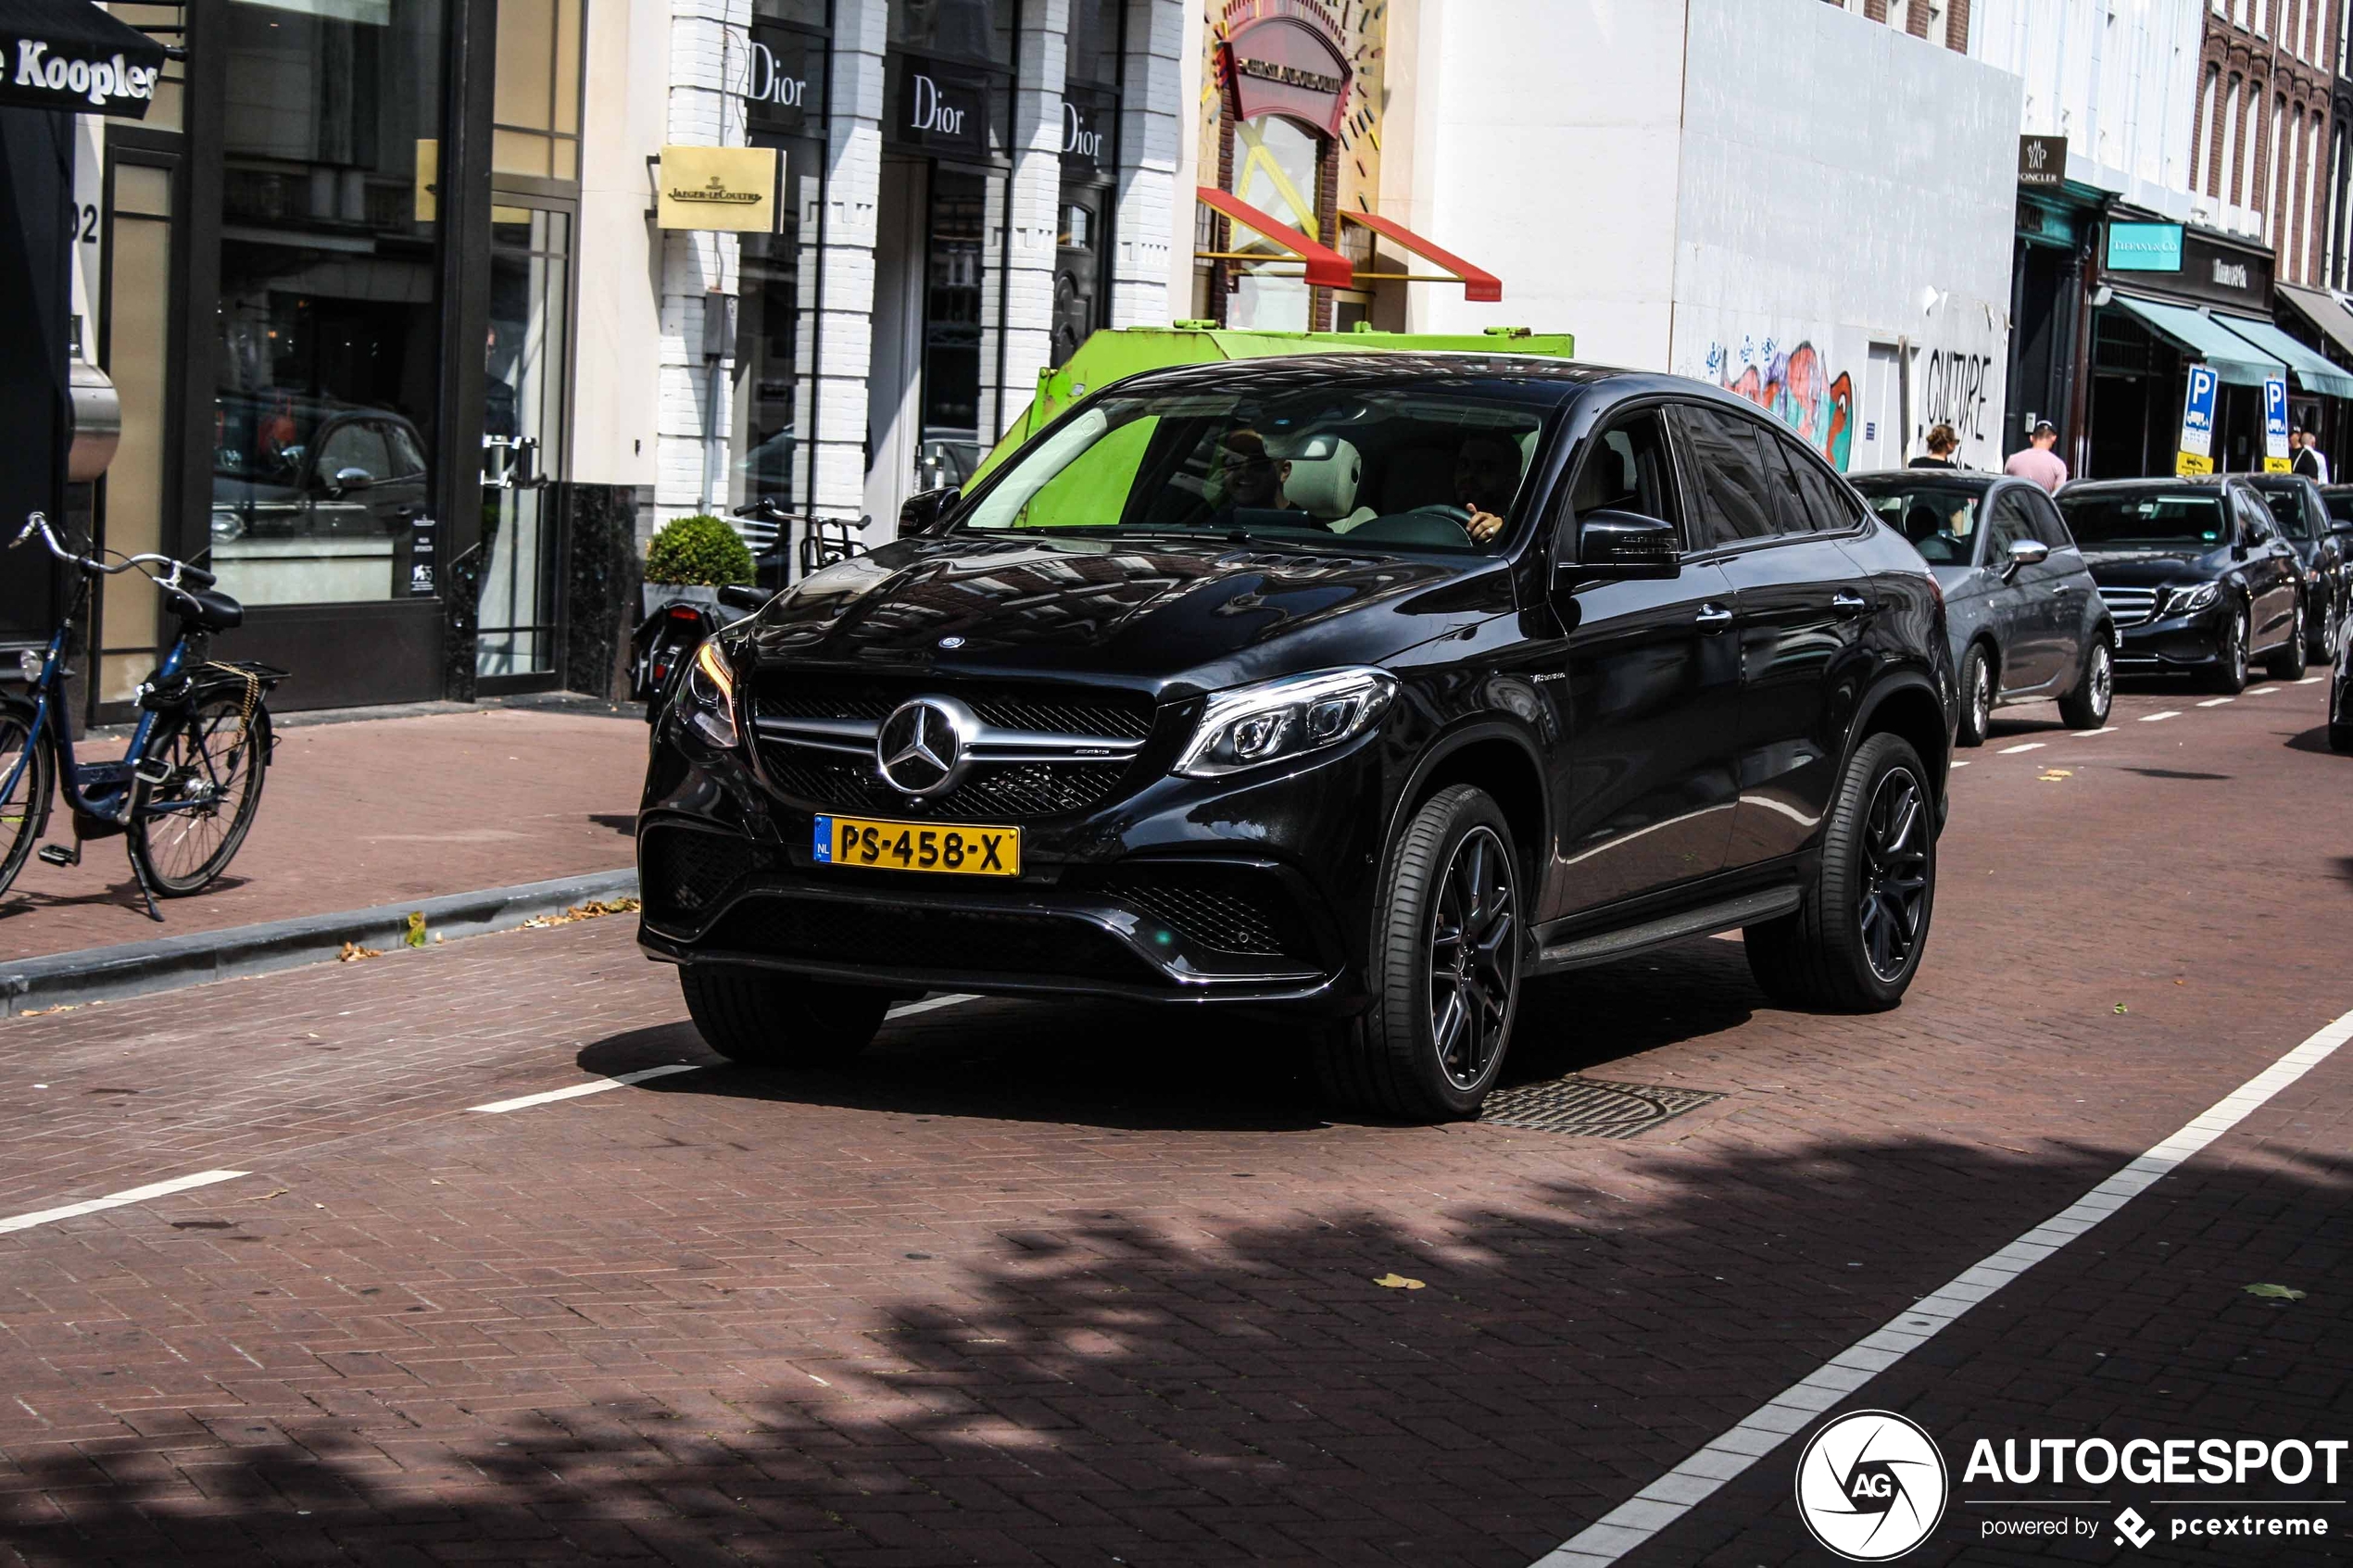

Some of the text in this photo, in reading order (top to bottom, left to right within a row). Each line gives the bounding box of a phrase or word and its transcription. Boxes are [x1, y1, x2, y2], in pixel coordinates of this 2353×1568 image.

[749, 42, 806, 107] Dior
[911, 73, 964, 136] Dior
[1927, 348, 1992, 442] CULTURE
[2192, 371, 2211, 405] P
[2268, 383, 2282, 413] P
[817, 824, 1003, 872] NL PS-458-X
